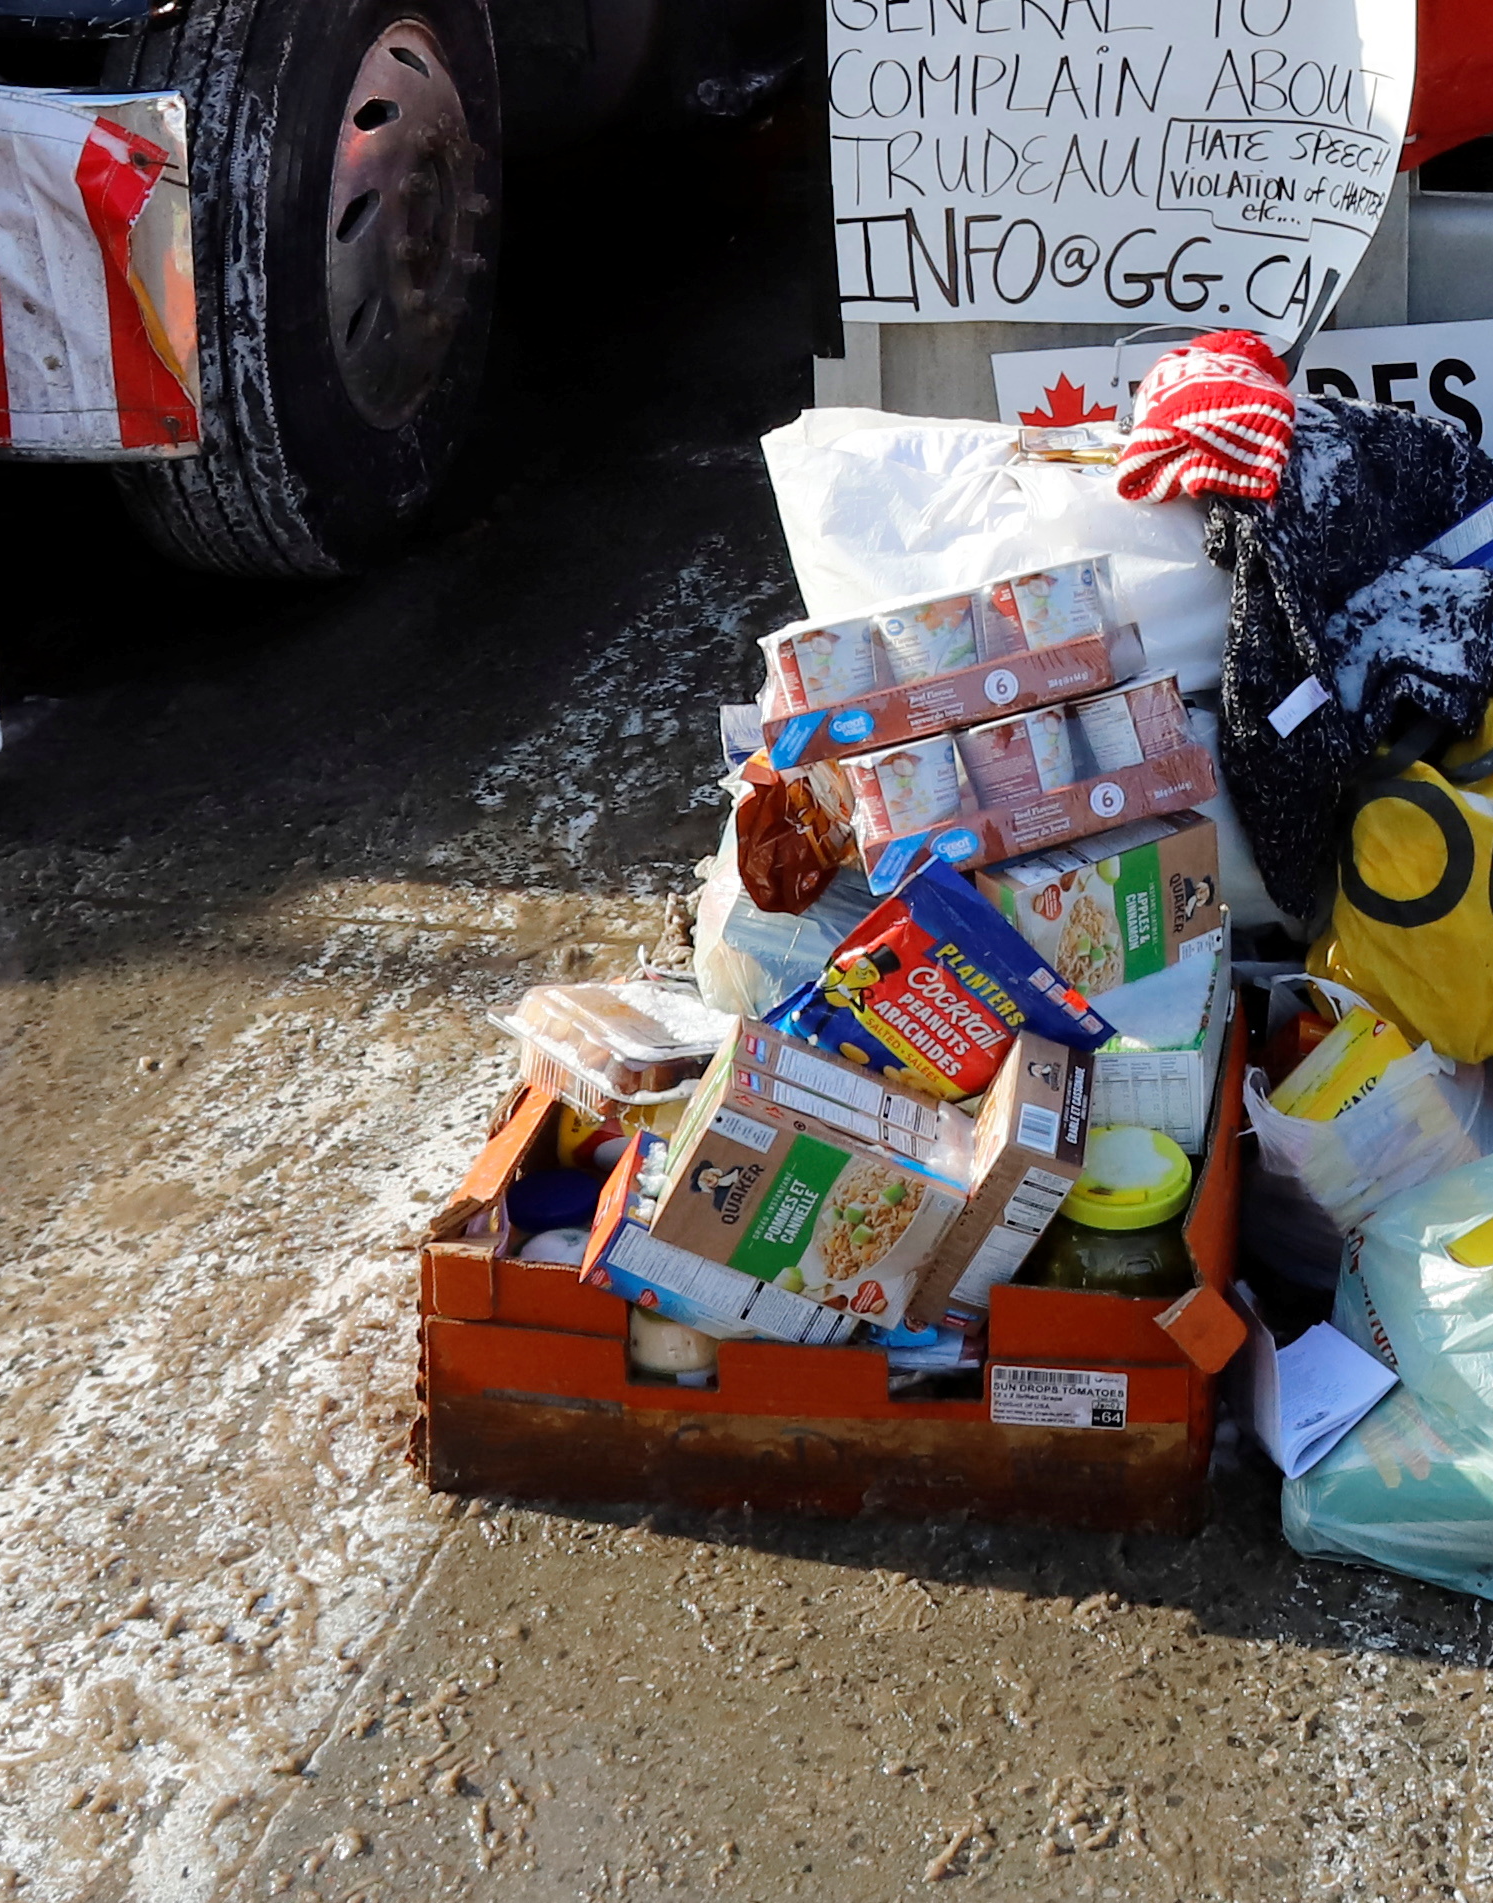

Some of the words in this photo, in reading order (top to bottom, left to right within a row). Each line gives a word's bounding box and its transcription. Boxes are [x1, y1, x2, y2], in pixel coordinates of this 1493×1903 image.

[1205, 49, 1399, 131] ABOUT
[831, 129, 1149, 204] TRUDEAU
[1186, 130, 1272, 164] HATE
[1294, 132, 1391, 174] SPEECH
[1329, 184, 1386, 221] CHARTER
[834, 206, 1312, 322] INFO@GG.CA
[996, 677, 1007, 694] 6
[833, 716, 866, 733] Great
[1102, 790, 1113, 808] 6
[1125, 893, 1141, 951] CINNAMON
[1137, 892, 1149, 931] APPLES
[1170, 873, 1185, 934] QUAKER
[908, 965, 1008, 1053] Cocktail
[935, 942, 1028, 1029] PLANTERS
[864, 1016, 900, 1050] SALTED
[874, 999, 963, 1077] ARACHIDES
[898, 992, 970, 1056] PEANUTS
[721, 1163, 765, 1224] QUAKER
[779, 1189, 820, 1245] CANNELLE
[993, 1382, 1016, 1392] SUN
[1020, 1384, 1058, 1394] DROPS
[1063, 1385, 1124, 1397] TOMATOES
[1101, 1412, 1121, 1423] 64
